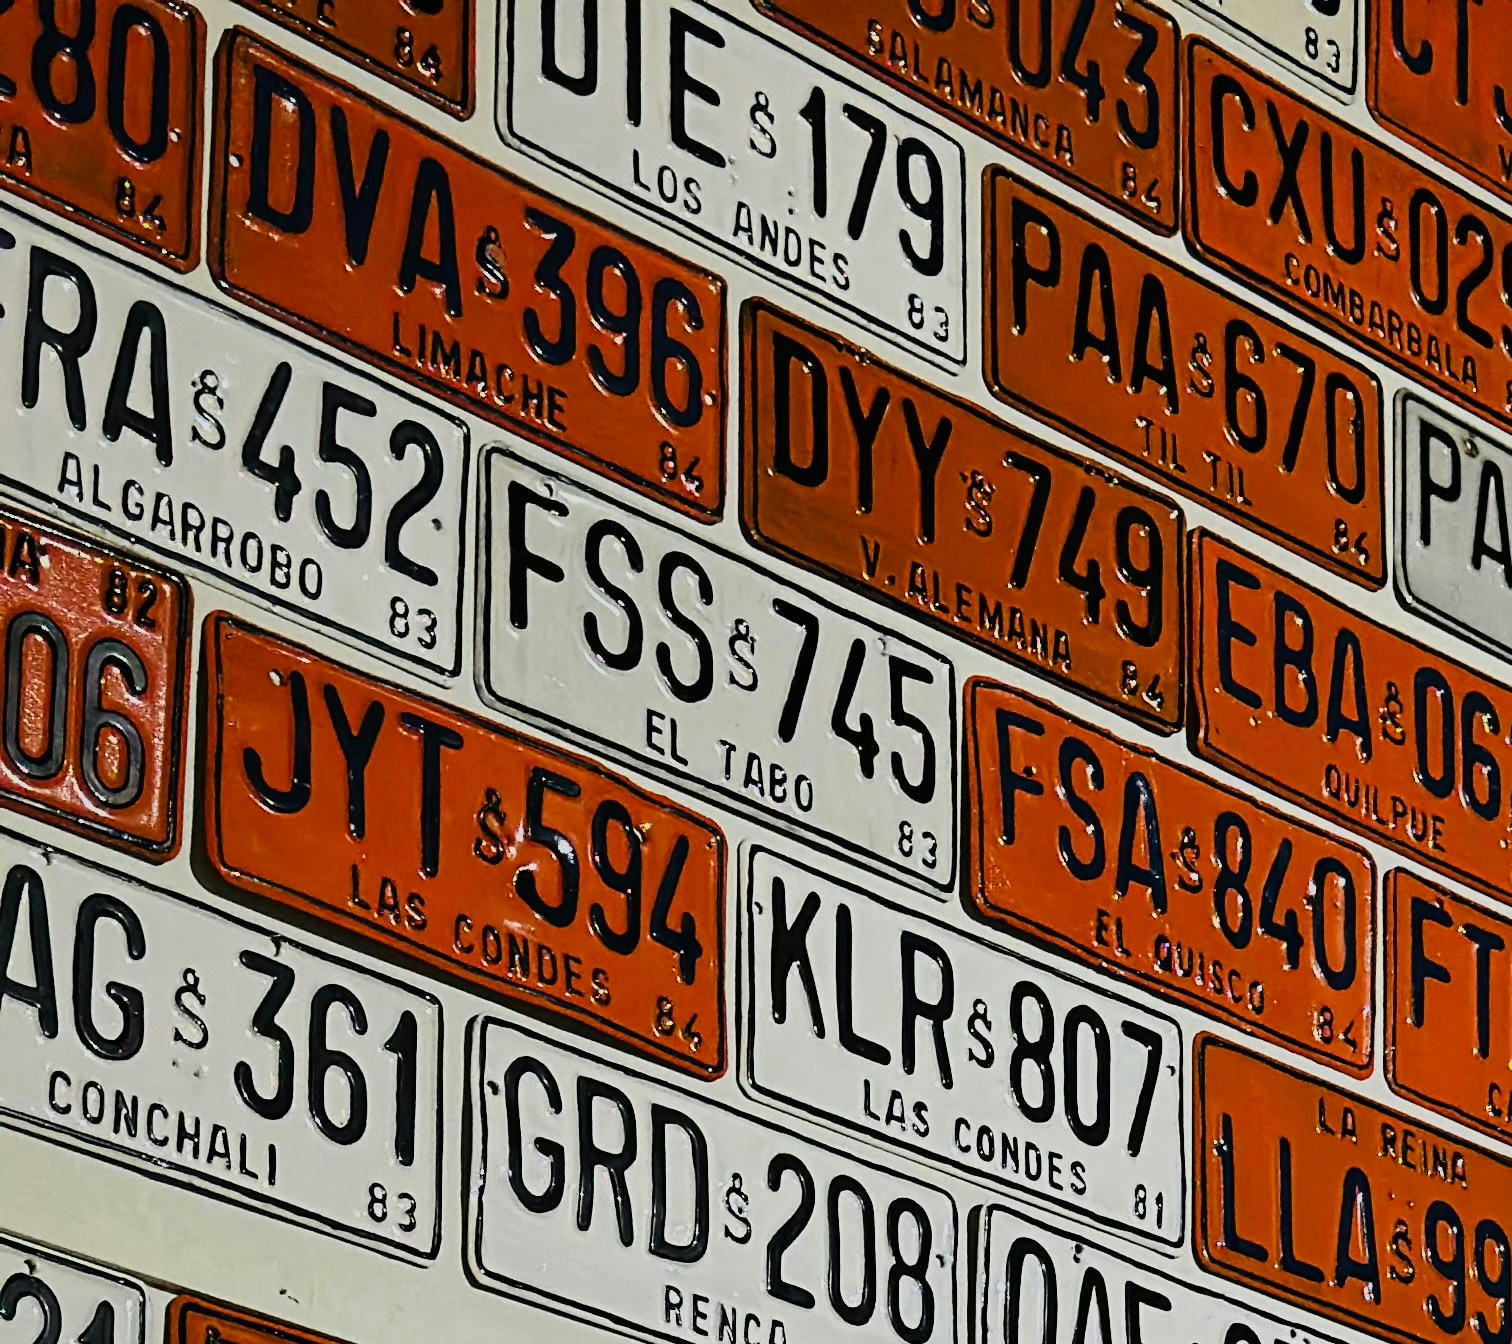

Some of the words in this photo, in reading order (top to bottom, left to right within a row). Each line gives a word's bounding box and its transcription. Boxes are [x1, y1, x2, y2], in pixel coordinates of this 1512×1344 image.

[868, 20, 1074, 167] SALAMANCA
[633, 149, 703, 214] LOS
[732, 201, 850, 291] ANDES
[908, 293, 948, 343] 83
[391, 311, 568, 433] LIMACHE
[1284, 253, 1477, 391] COMBARBALA
[58, 453, 323, 600] ALGARROBO
[388, 596, 438, 651] 83
[645, 709, 689, 768] EL
[718, 740, 814, 812] TABO
[1322, 762, 1445, 853] QUILPUE
[348, 863, 428, 932] LAS
[454, 914, 612, 1008] CONDES
[49, 1069, 277, 1187] CONCHALI
[367, 1183, 418, 1232] 83
[864, 1080, 930, 1137] LAS
[954, 1120, 1088, 1196] CONDES
[1133, 1184, 1165, 1229] 81
